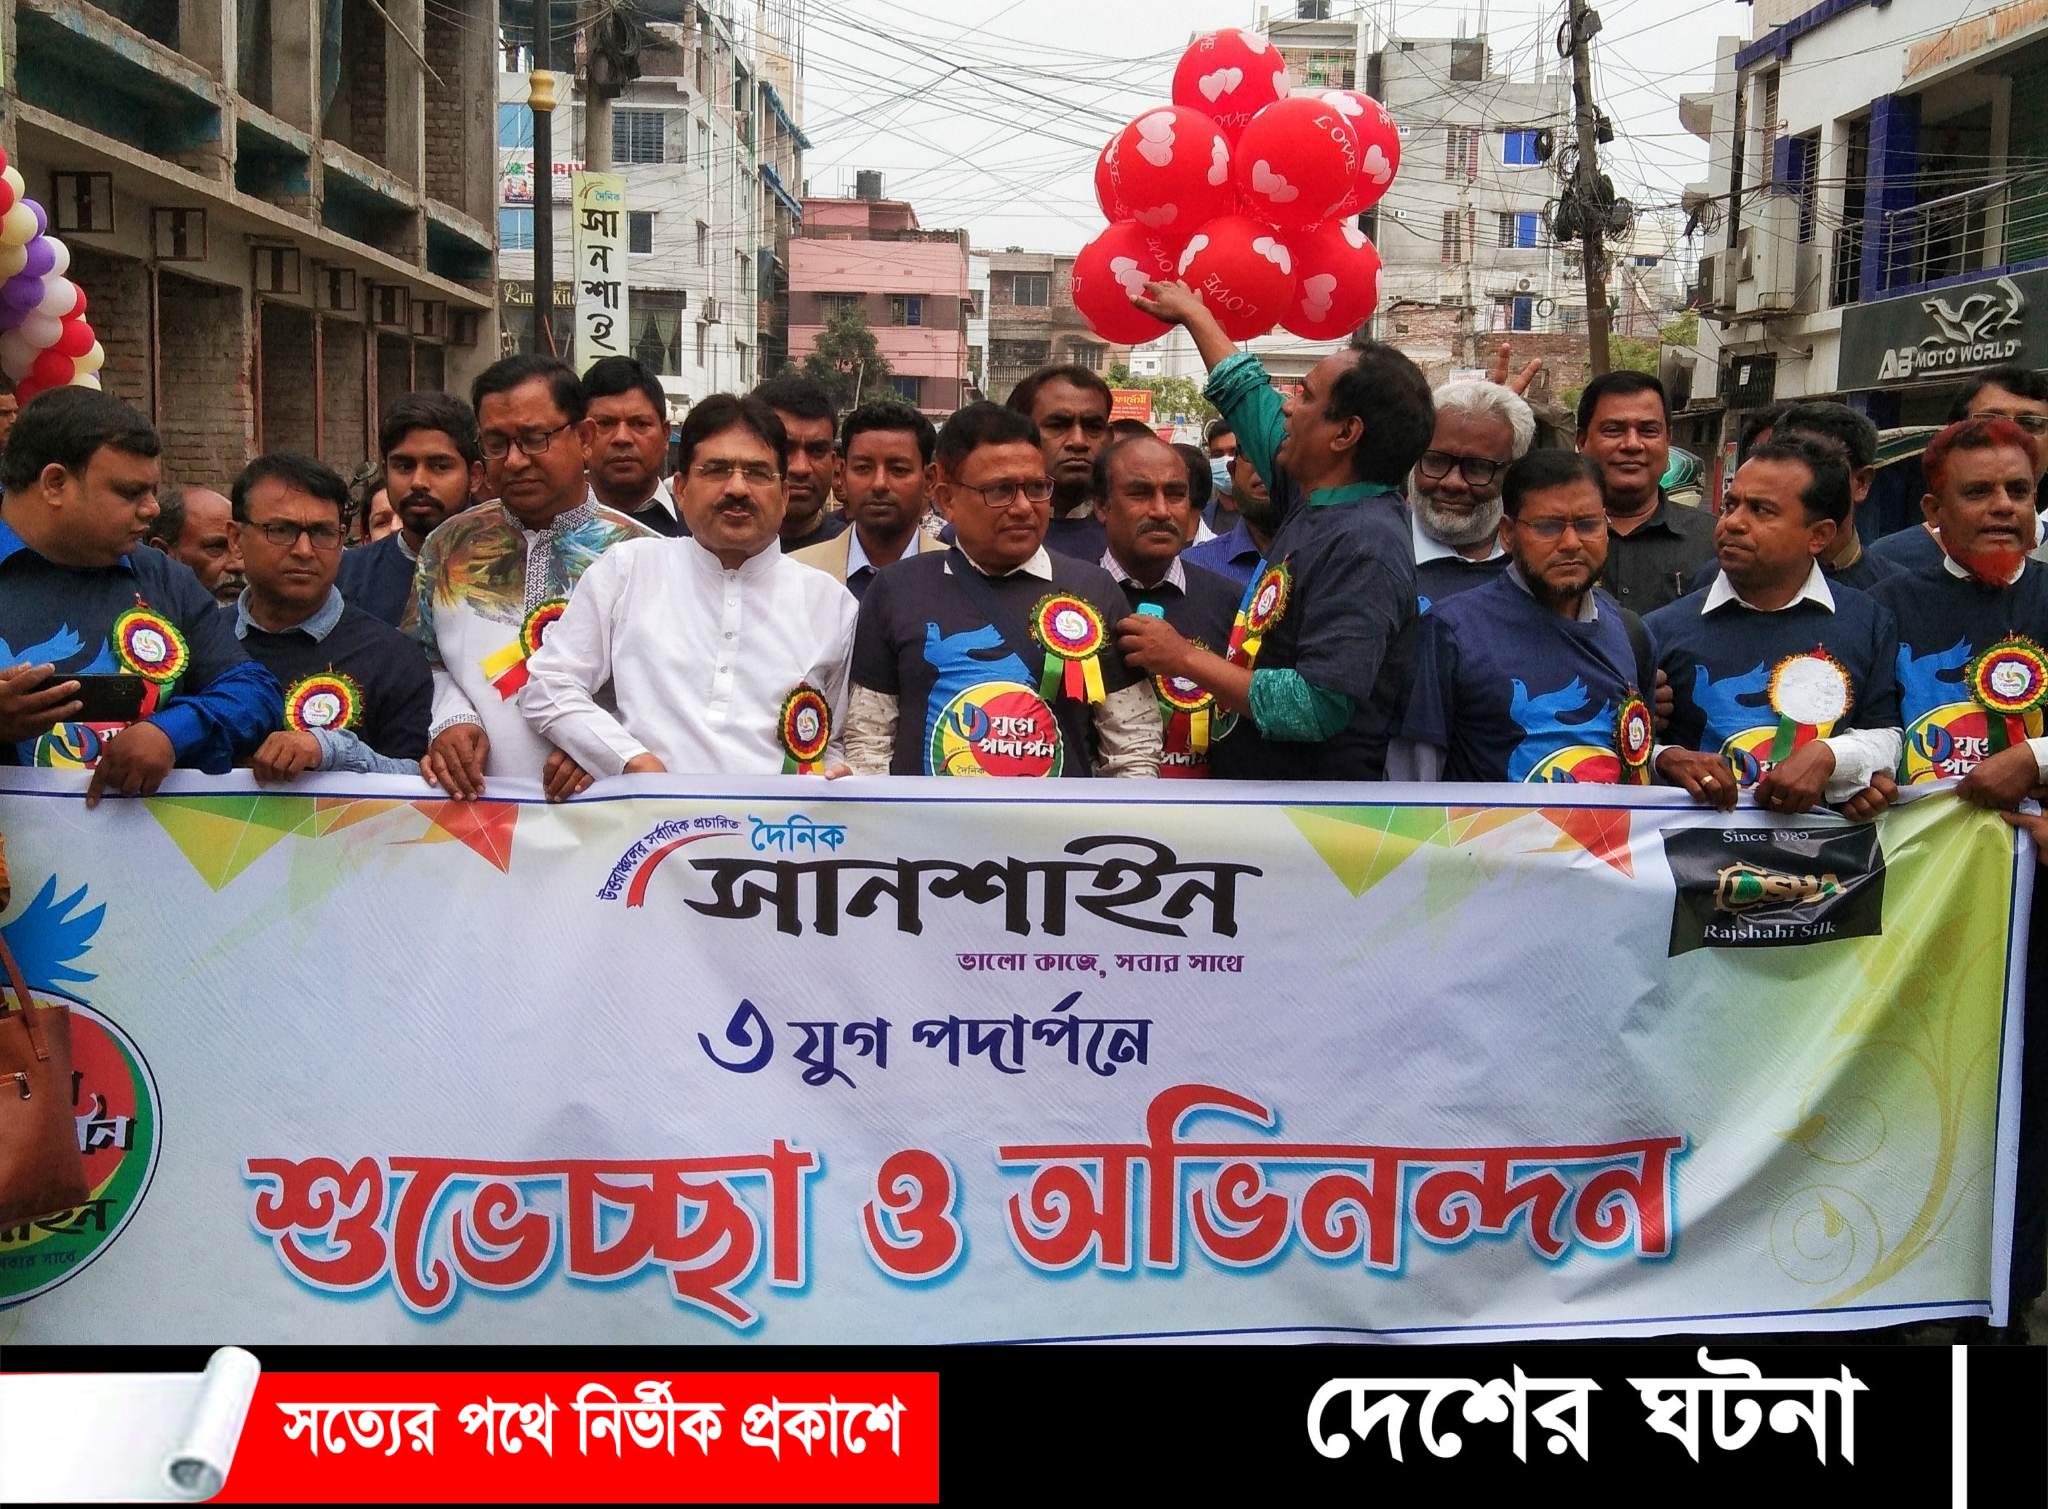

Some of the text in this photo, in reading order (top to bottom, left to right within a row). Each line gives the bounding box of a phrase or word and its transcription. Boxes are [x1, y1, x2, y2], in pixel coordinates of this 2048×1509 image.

[1212, 112, 1251, 129] OVE
[1313, 115, 1356, 175] LOVE
[1146, 236, 1174, 273] OVE
[503, 281, 575, 305] Rin Kit
[579, 208, 622, 359] সানশাই
[1203, 272, 1258, 319] LOVE
[1915, 350, 1956, 368] MOTO
[1960, 341, 2016, 363] WORLD
[990, 715, 1035, 740] যুগে
[643, 819, 690, 845] সর্বাধিক
[693, 814, 742, 830] প্রচারিত
[748, 814, 847, 853] দৈনিক
[1722, 830, 1768, 844] Since
[683, 835, 1263, 938] সানশাইন
[1703, 921, 1837, 943] Rajshahi Silk
[956, 953, 1245, 979] ভালো কাজে, সবার সাথে
[698, 990, 1154, 1088] ৩ যুগ পদার্পনে
[245, 1083, 1684, 1324] শুভেচ্ছা ও অভিনন্দন
